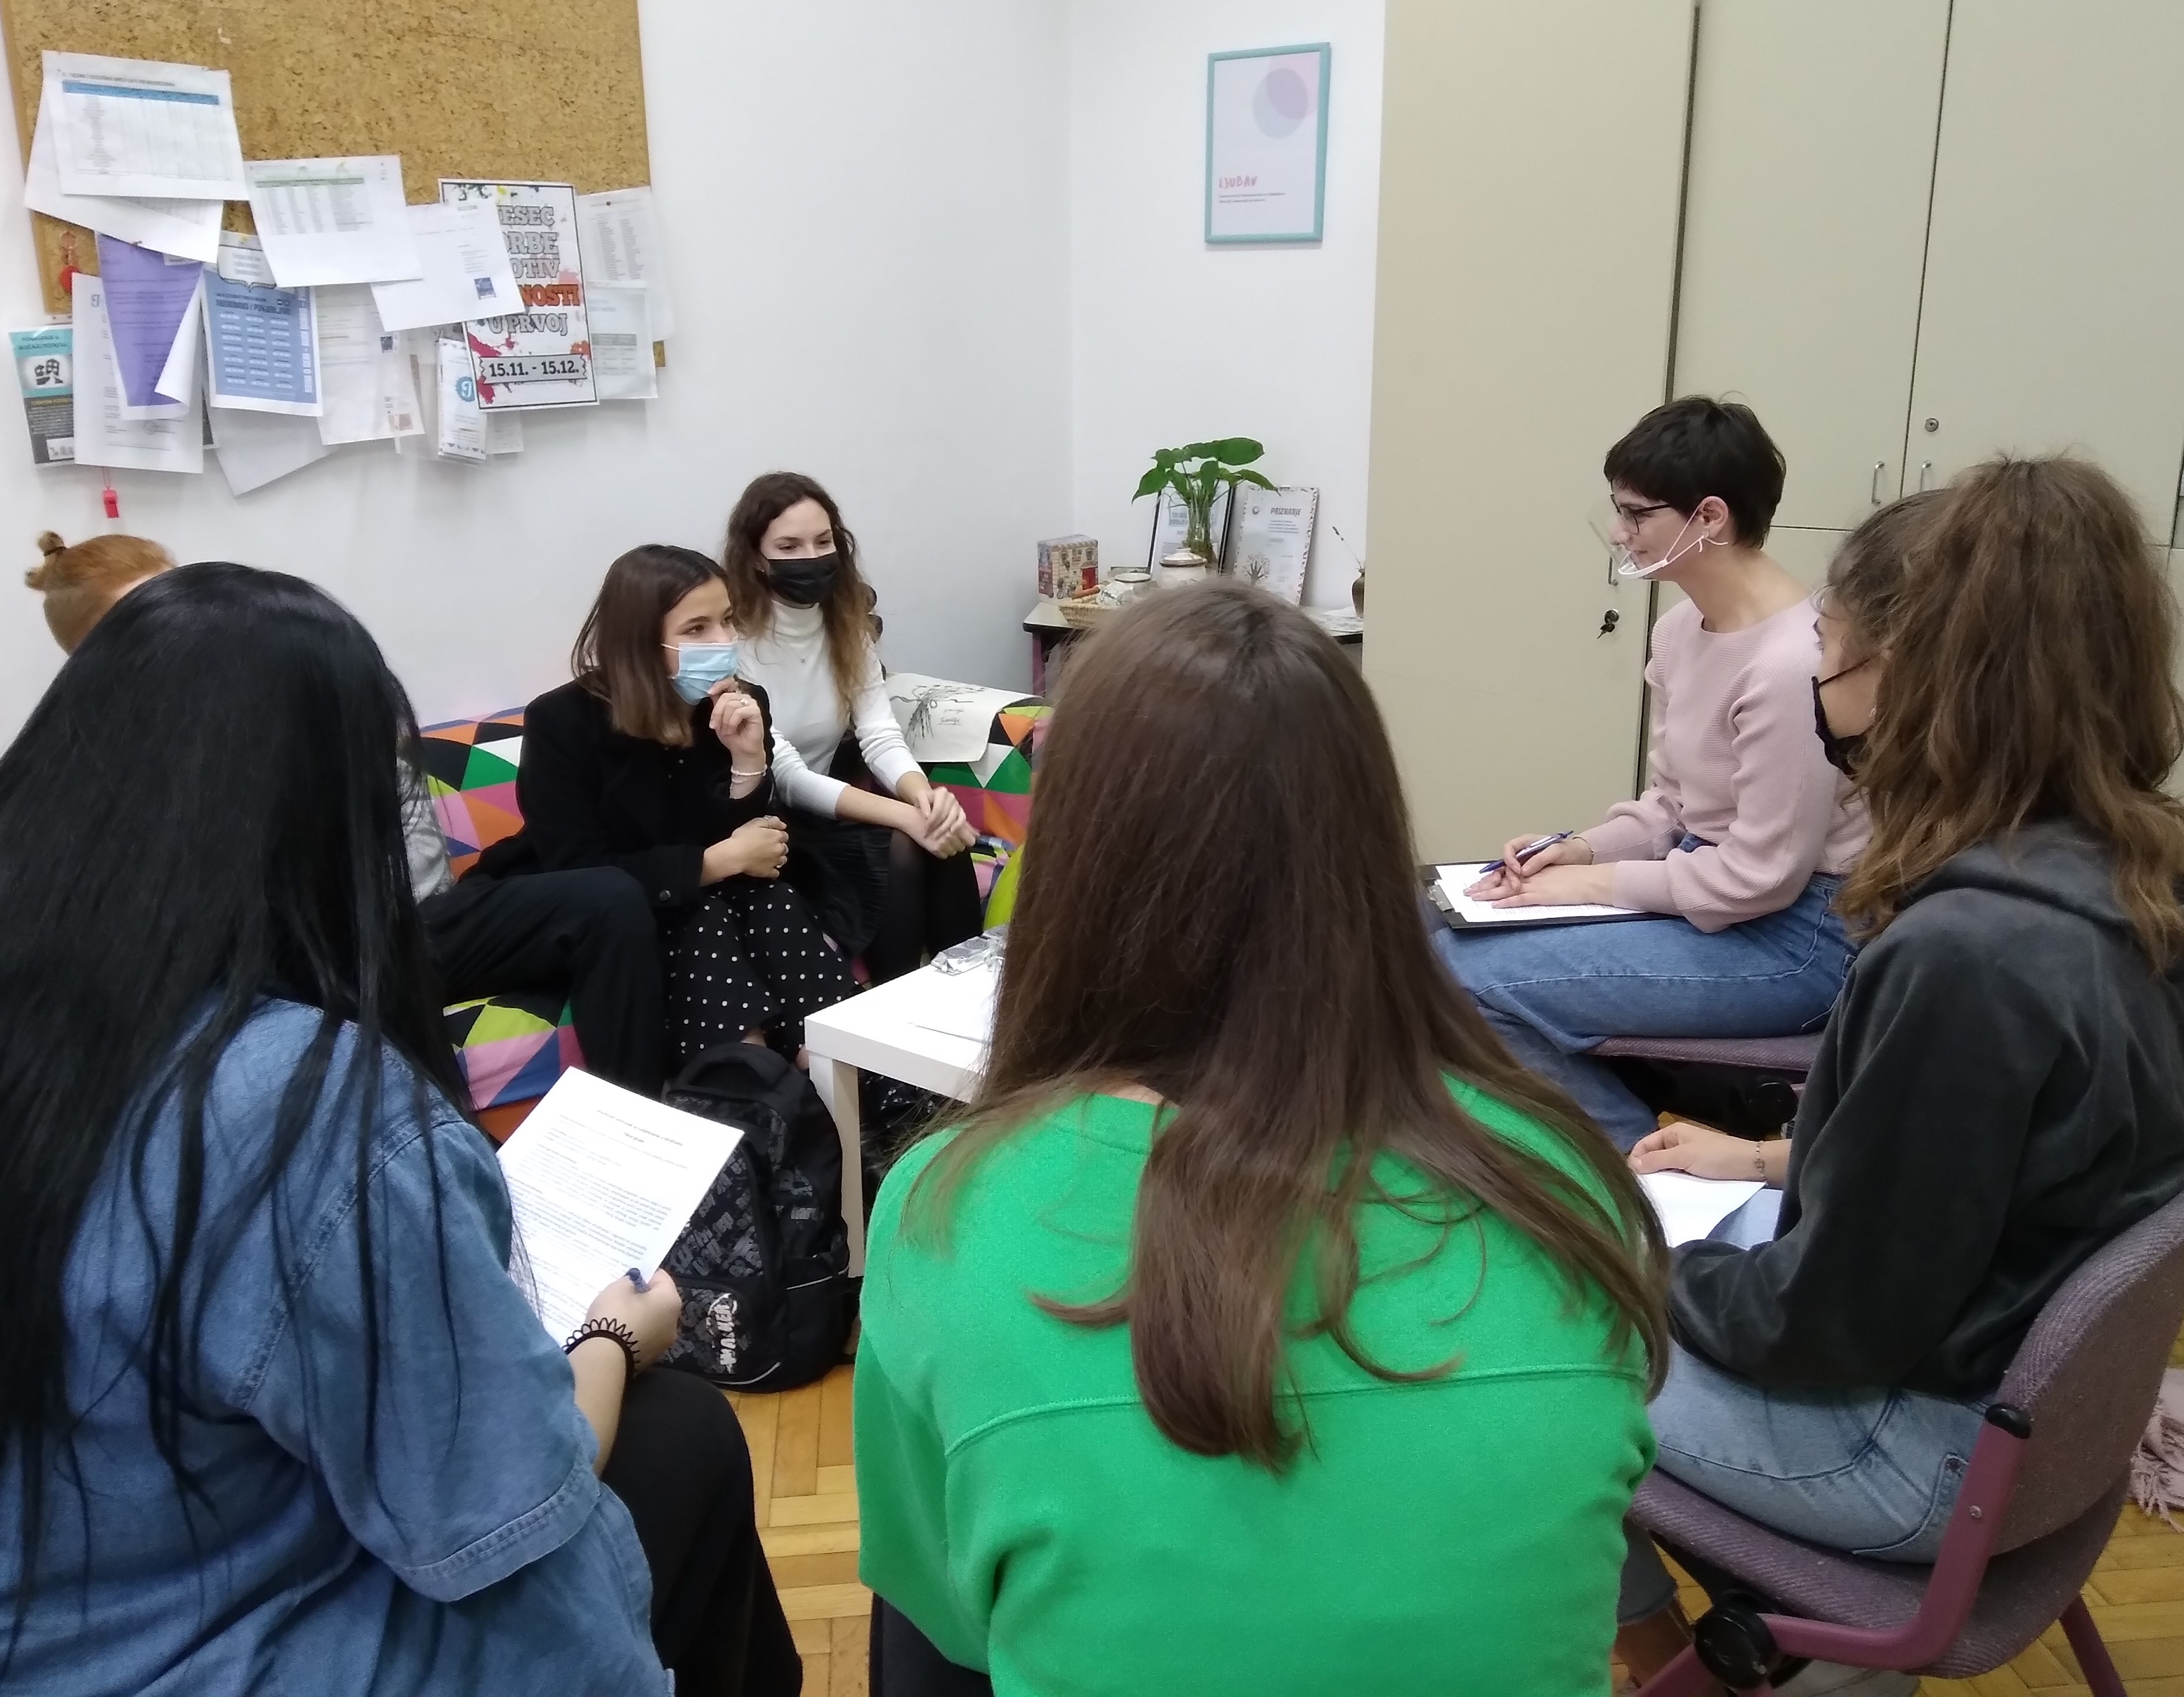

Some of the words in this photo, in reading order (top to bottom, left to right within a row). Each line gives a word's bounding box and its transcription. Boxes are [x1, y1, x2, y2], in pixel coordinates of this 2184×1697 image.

[497, 205, 555, 226] ESEC
[487, 316, 503, 334] U
[506, 313, 568, 336] PRVOJ
[488, 362, 529, 378] 15.11.
[541, 360, 579, 375] 15.12.
[1270, 507, 1301, 517] PRIZNANJE
